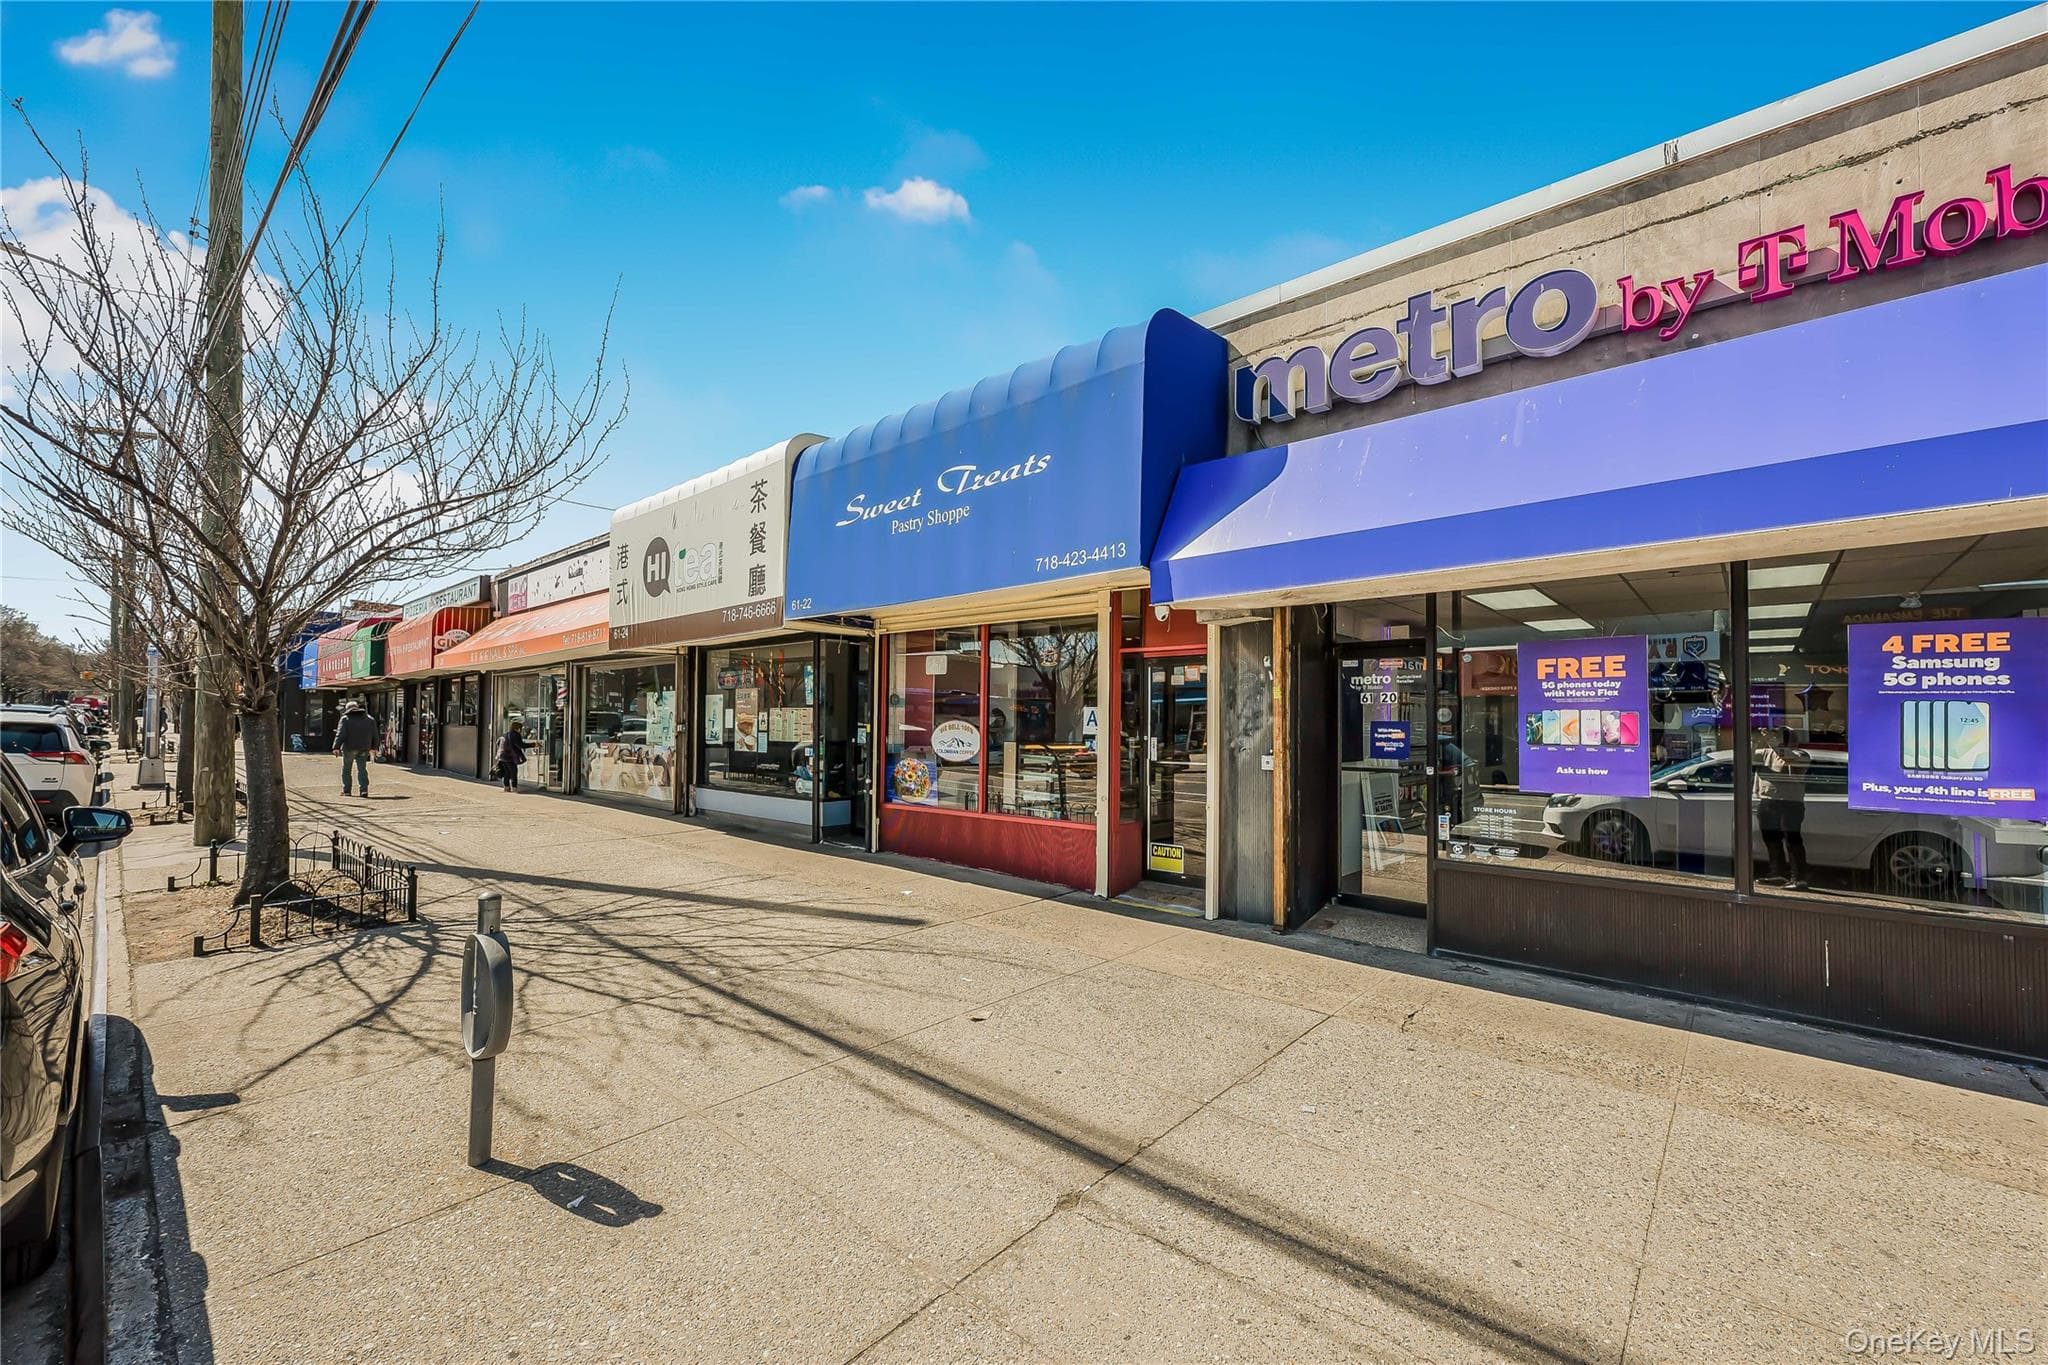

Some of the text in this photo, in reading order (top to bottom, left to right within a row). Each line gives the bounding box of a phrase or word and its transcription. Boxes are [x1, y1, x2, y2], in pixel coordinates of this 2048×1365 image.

[1233, 268, 1600, 426] metro
[1617, 268, 1714, 342] by
[835, 451, 1052, 527] Sweet Treats
[891, 504, 970, 535] Pastry Shoppe
[748, 478, 768, 597] 茶餐廳
[646, 551, 667, 584] HI
[673, 541, 717, 589] tea
[1035, 542, 1127, 572] 718-423-4413
[722, 601, 776, 623] 718-746-6666
[791, 598, 811, 611] 61-22
[613, 627, 629, 640] 61-24
[1882, 631, 2011, 654] 4 FREE
[1537, 655, 1627, 680] FREE
[1892, 655, 2000, 671] Samsung
[1351, 673, 1391, 685] metro
[1541, 680, 1621, 690] 5G phones today
[1883, 672, 2010, 689] 5G phones
[1361, 693, 1397, 703] 61 20
[1544, 690, 1565, 698] with
[1598, 689, 1619, 697] Flex
[1086, 710, 1098, 727] A
[1556, 766, 1574, 775] Ask
[1587, 767, 1609, 775] how
[1862, 782, 2033, 799] Plus, your 4th line is FREE
[1494, 807, 1517, 815] HOURS
[1152, 845, 1182, 860] CAUTION
